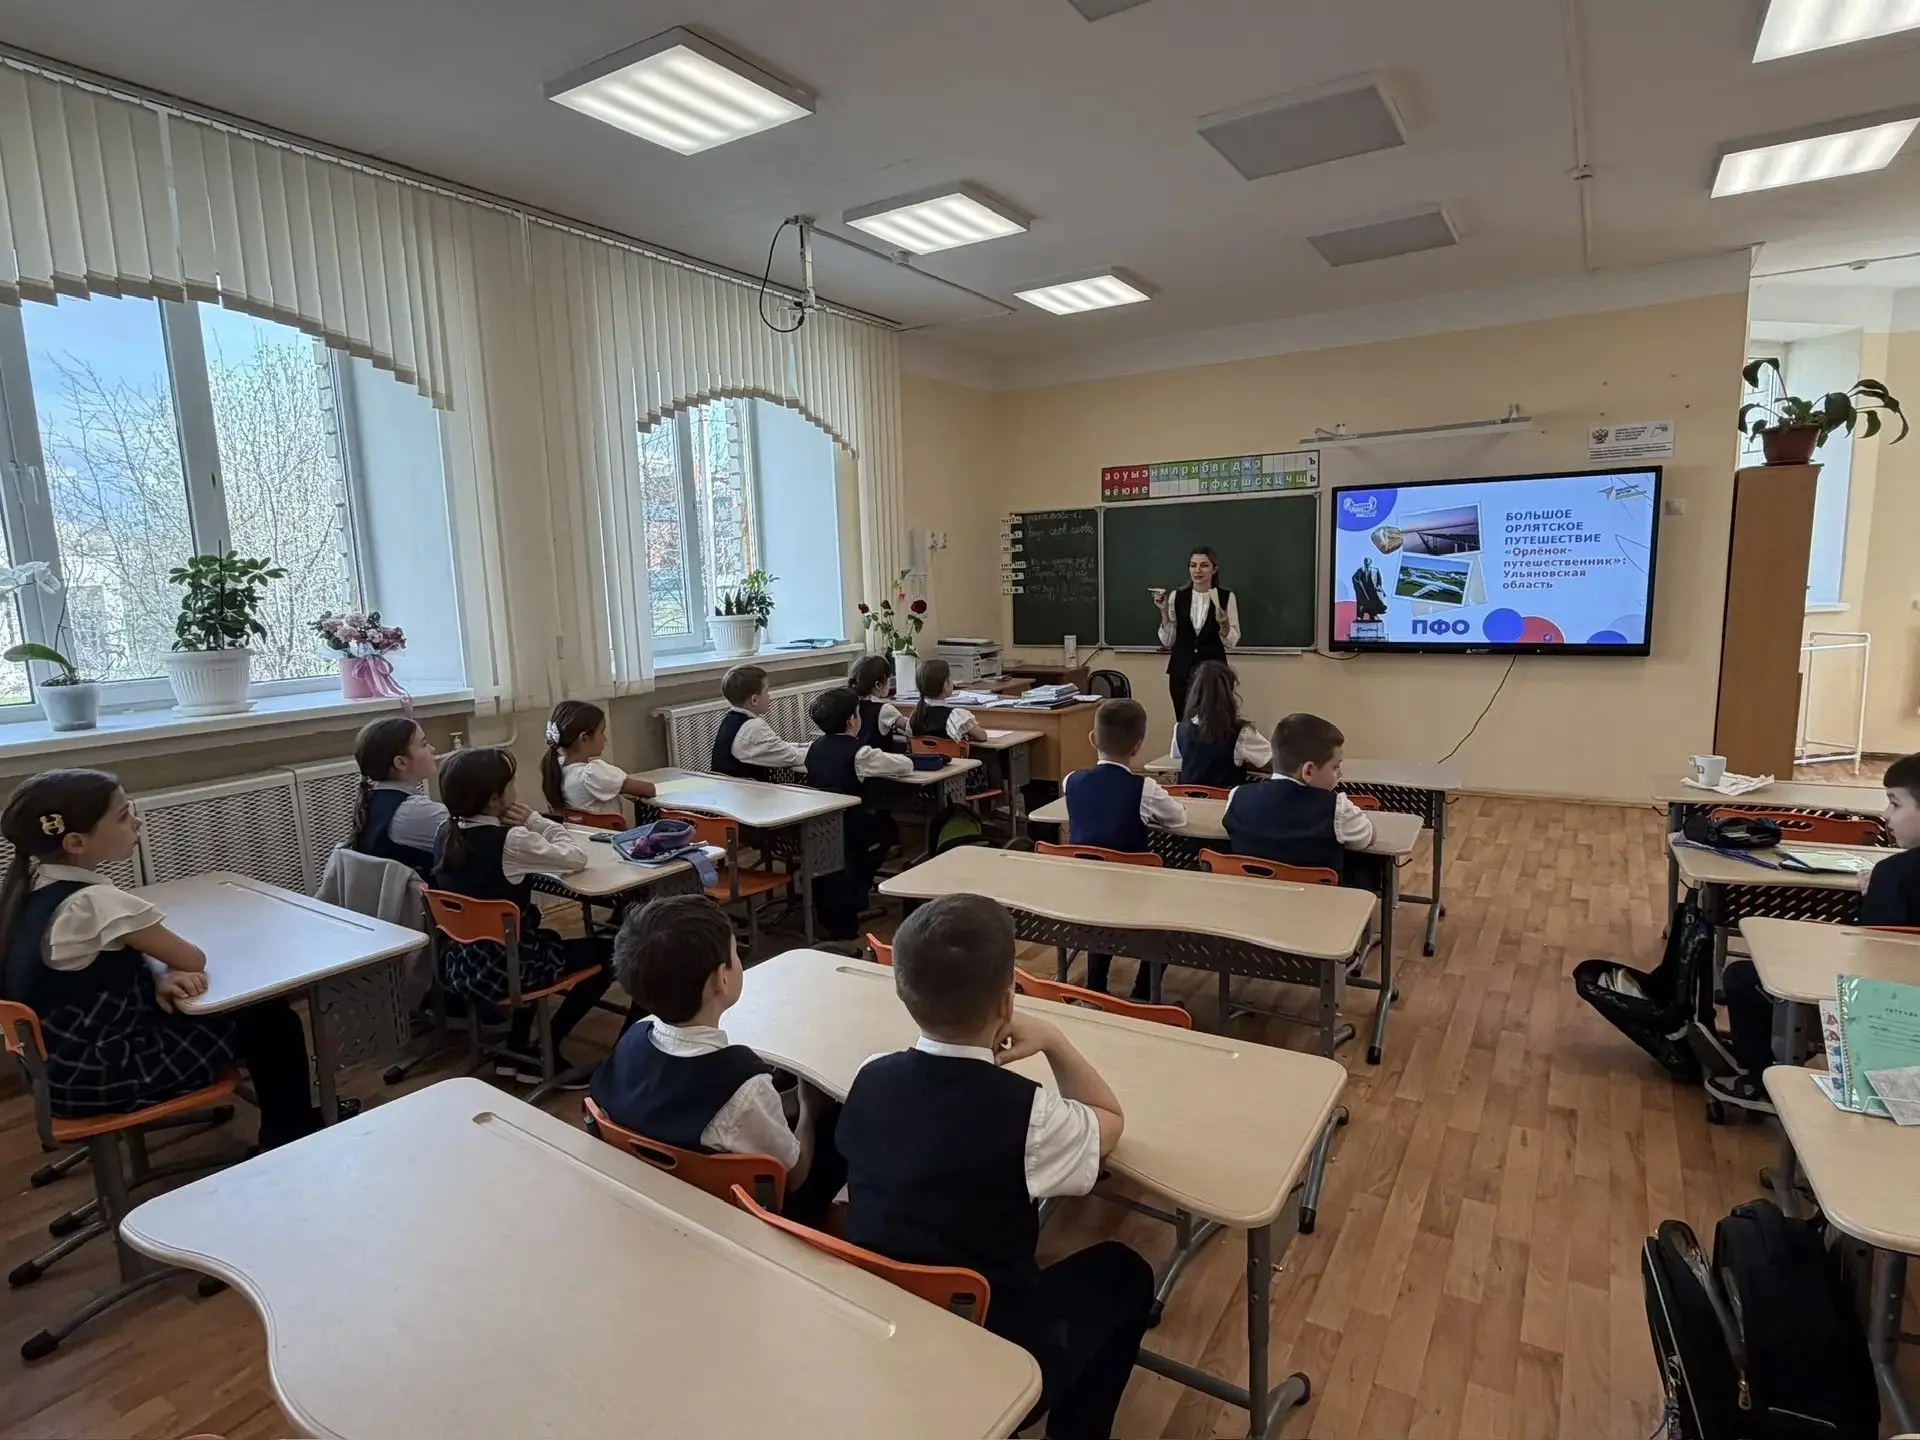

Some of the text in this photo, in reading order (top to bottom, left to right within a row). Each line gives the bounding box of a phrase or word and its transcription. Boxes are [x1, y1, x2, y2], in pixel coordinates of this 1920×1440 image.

[1505, 509, 1573, 522] БОЛЬШОЕ
[1505, 521, 1584, 533] ОРЛЯТСКОЕ
[1504, 533, 1602, 546] ПУТЕШЕСТВИЕ
[1504, 546, 1573, 558] «Орлёнок-
[1503, 557, 1627, 569] путешественник»:
[1503, 569, 1587, 579] Ульяновская
[1502, 580, 1554, 589] область
[1411, 618, 1471, 636] ПФО
